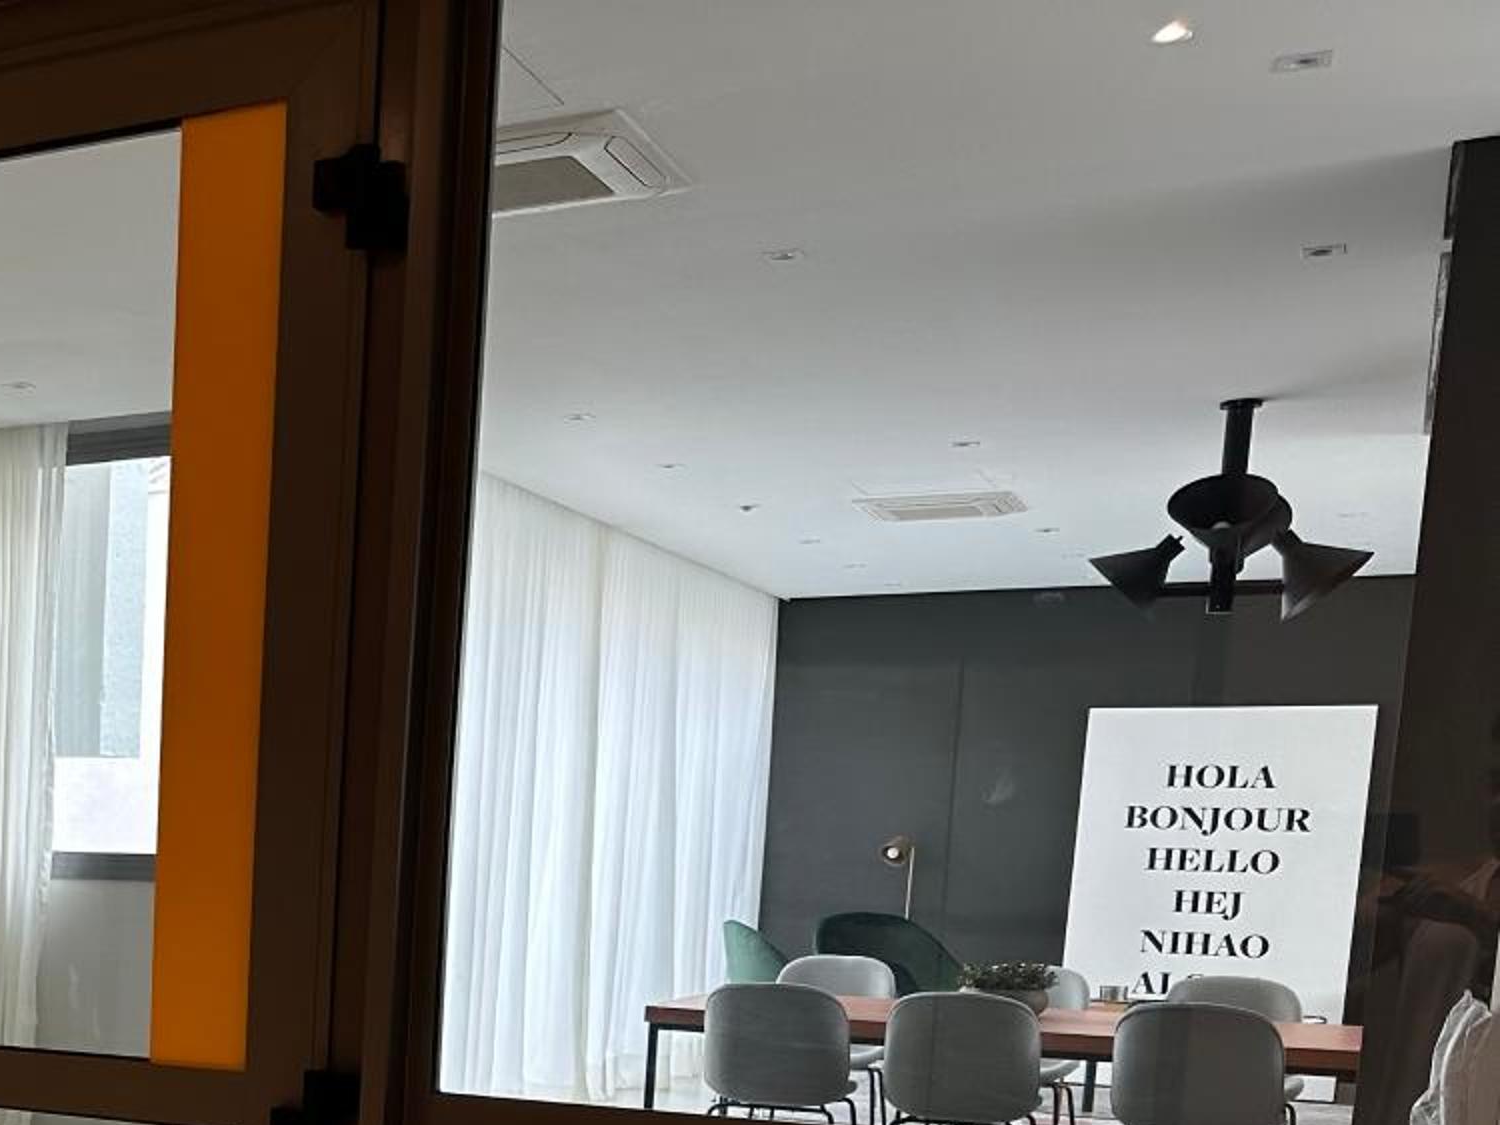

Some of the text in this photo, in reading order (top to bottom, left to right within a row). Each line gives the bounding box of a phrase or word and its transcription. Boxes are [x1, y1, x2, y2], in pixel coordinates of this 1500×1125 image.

[1166, 764, 1276, 789] HOLA
[1124, 805, 1311, 836] BONJOUR
[1144, 847, 1280, 874] HELLO
[1172, 889, 1245, 920] HEJ
[1140, 929, 1269, 958] NIHAO
